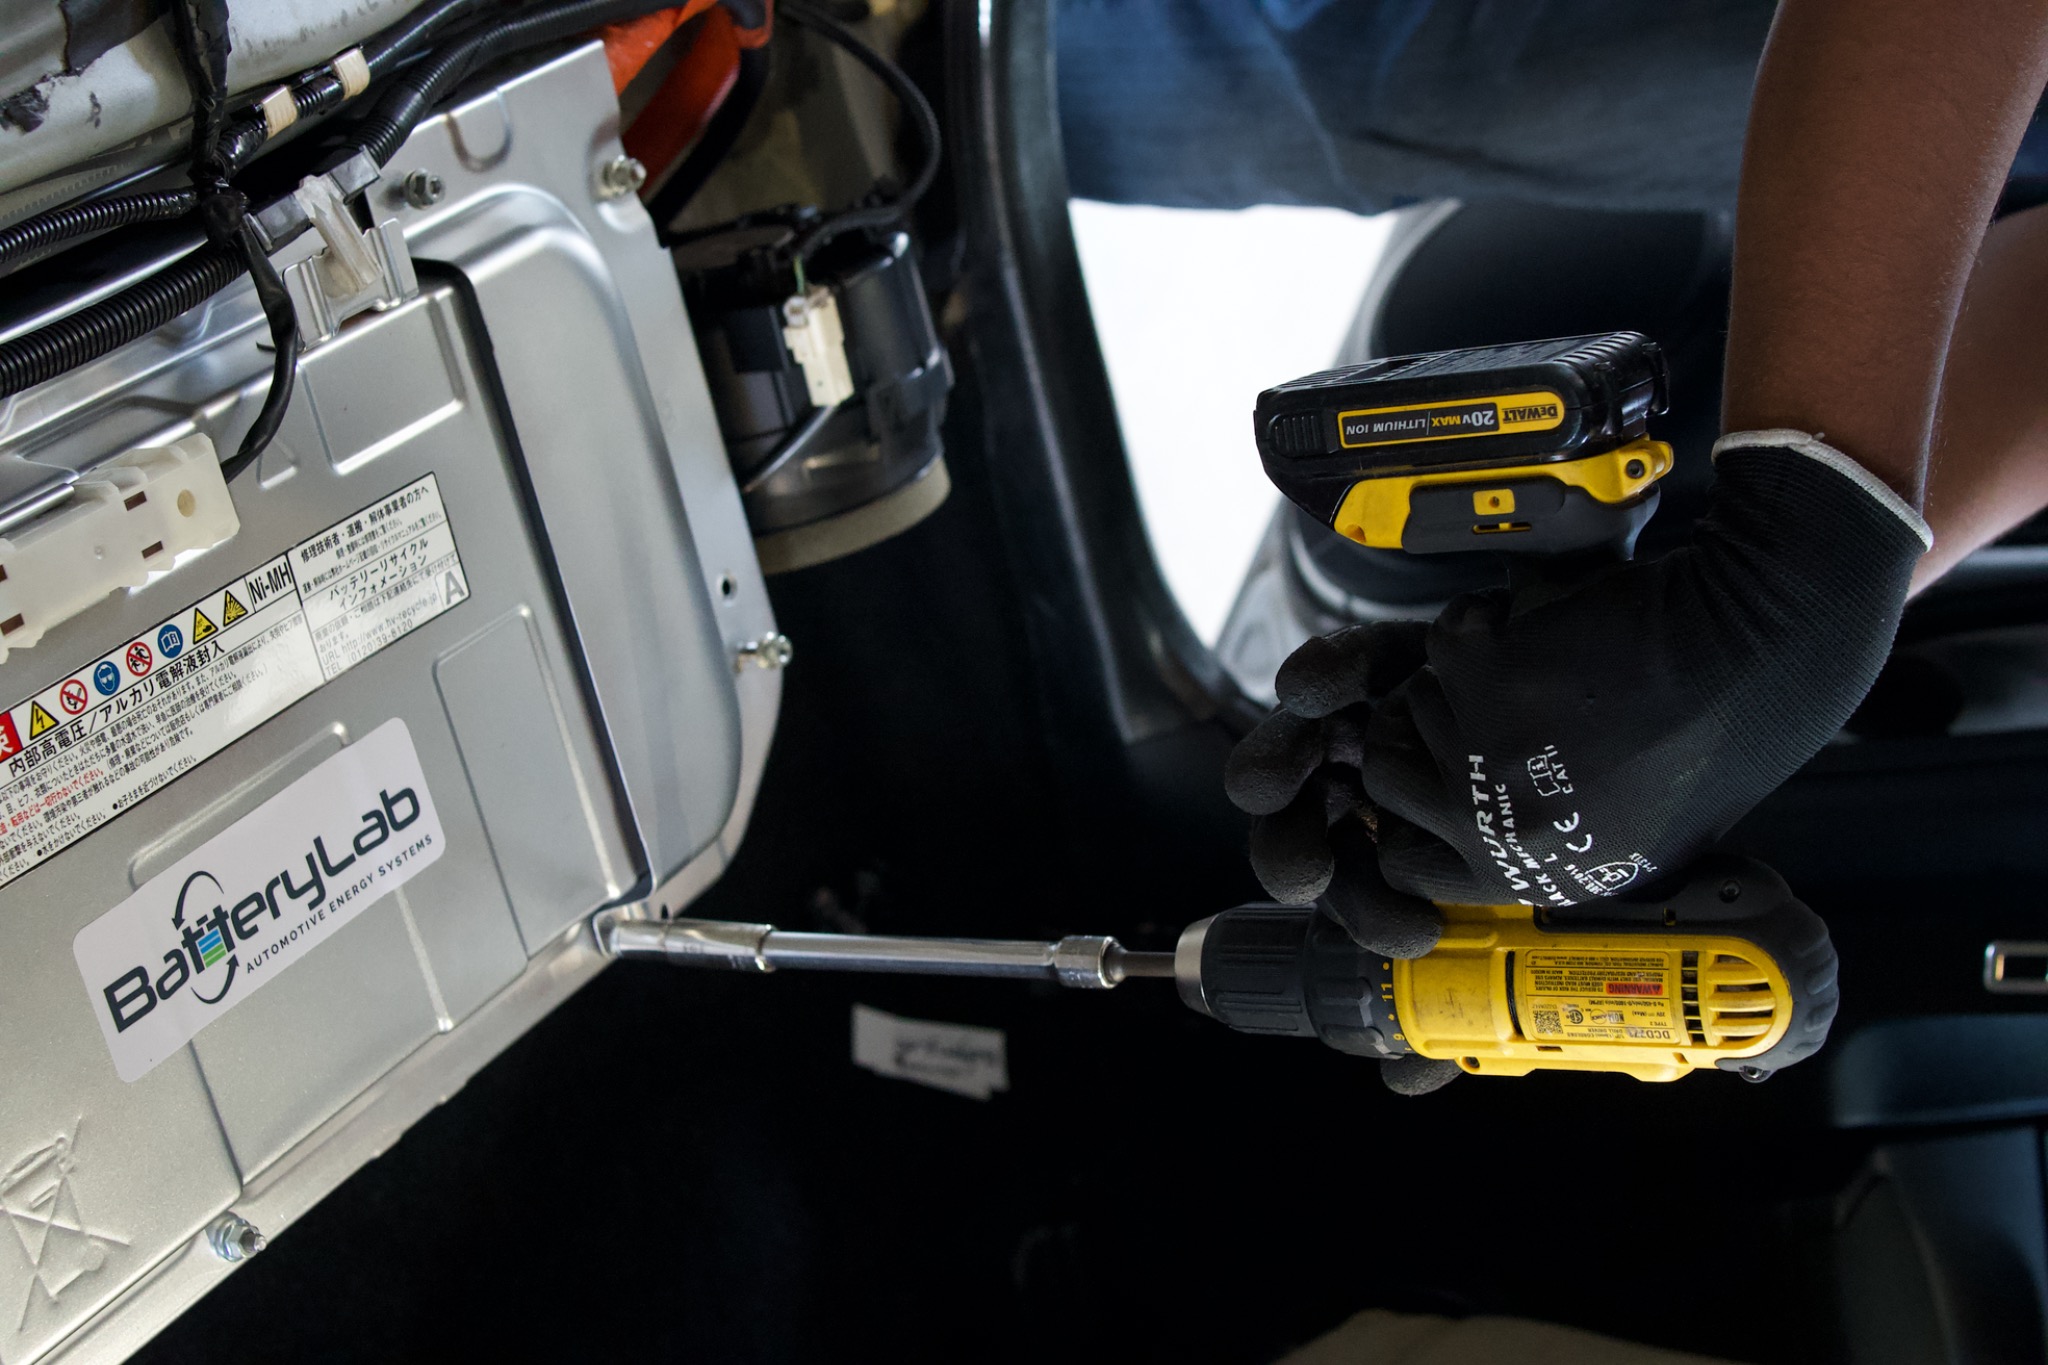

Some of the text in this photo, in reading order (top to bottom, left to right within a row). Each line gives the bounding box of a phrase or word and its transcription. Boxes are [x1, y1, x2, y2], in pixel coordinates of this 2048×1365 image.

[1346, 418, 1426, 435] LITHIUM ION
[1502, 405, 1558, 422] DEWALT
[249, 562, 292, 604] Ni-MH
[328, 533, 429, 603] バッテリーリサイクル
[338, 550, 428, 614] インフォメーション
[438, 566, 465, 606] A
[321, 647, 340, 667] URL
[325, 659, 342, 678] TEL
[1551, 763, 1574, 794] CAT
[1495, 784, 1541, 870] MECHANIC
[103, 787, 420, 1034] BatteryLab
[246, 834, 433, 974] AUTOMOTIVE ENERGY SYSTEMS
[1381, 983, 1393, 1002] 11
[1608, 983, 1650, 994] WARNING
